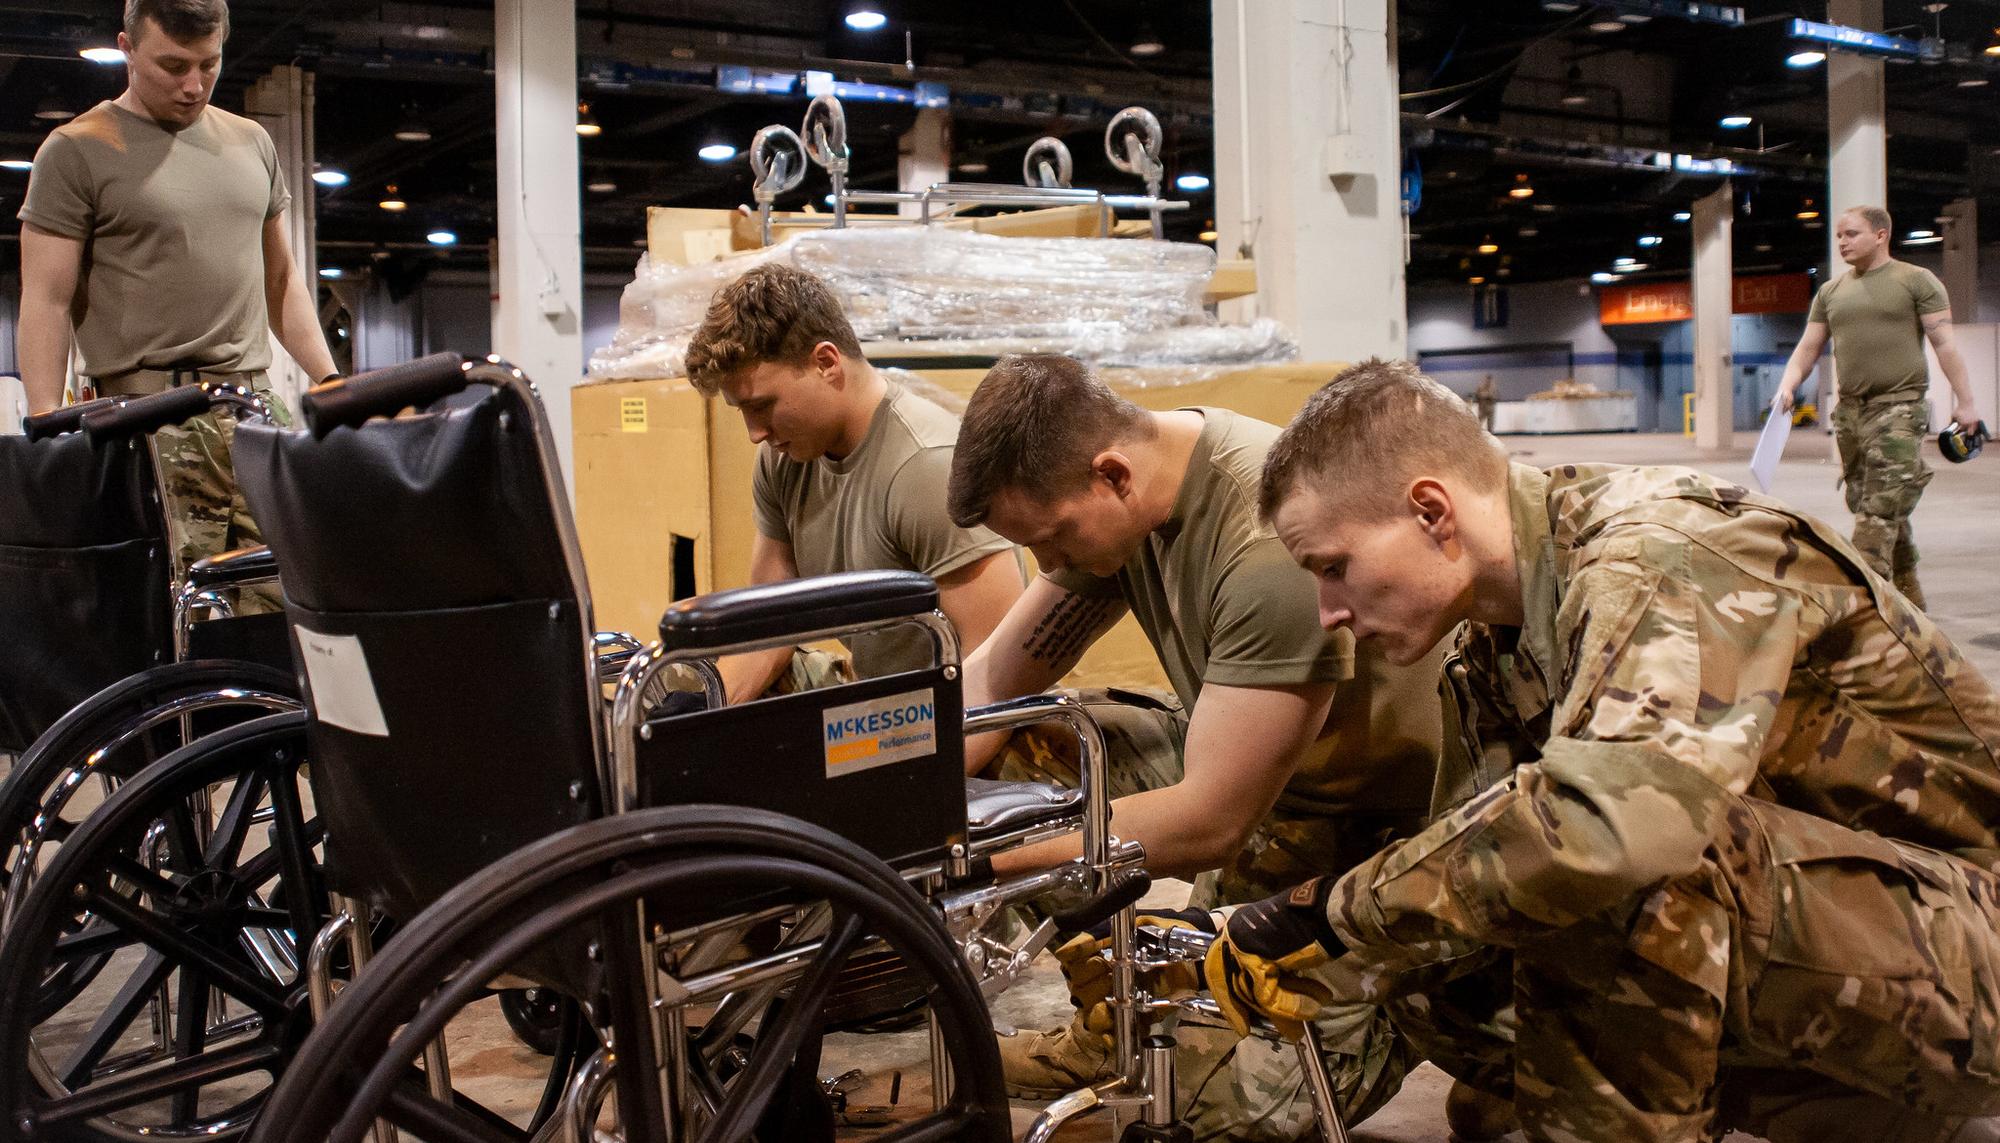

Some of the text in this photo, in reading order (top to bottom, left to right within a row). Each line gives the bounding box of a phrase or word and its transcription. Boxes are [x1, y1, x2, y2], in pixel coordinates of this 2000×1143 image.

[1625, 281, 1778, 314] Emerg Exit
[878, 732, 932, 750] Performance
